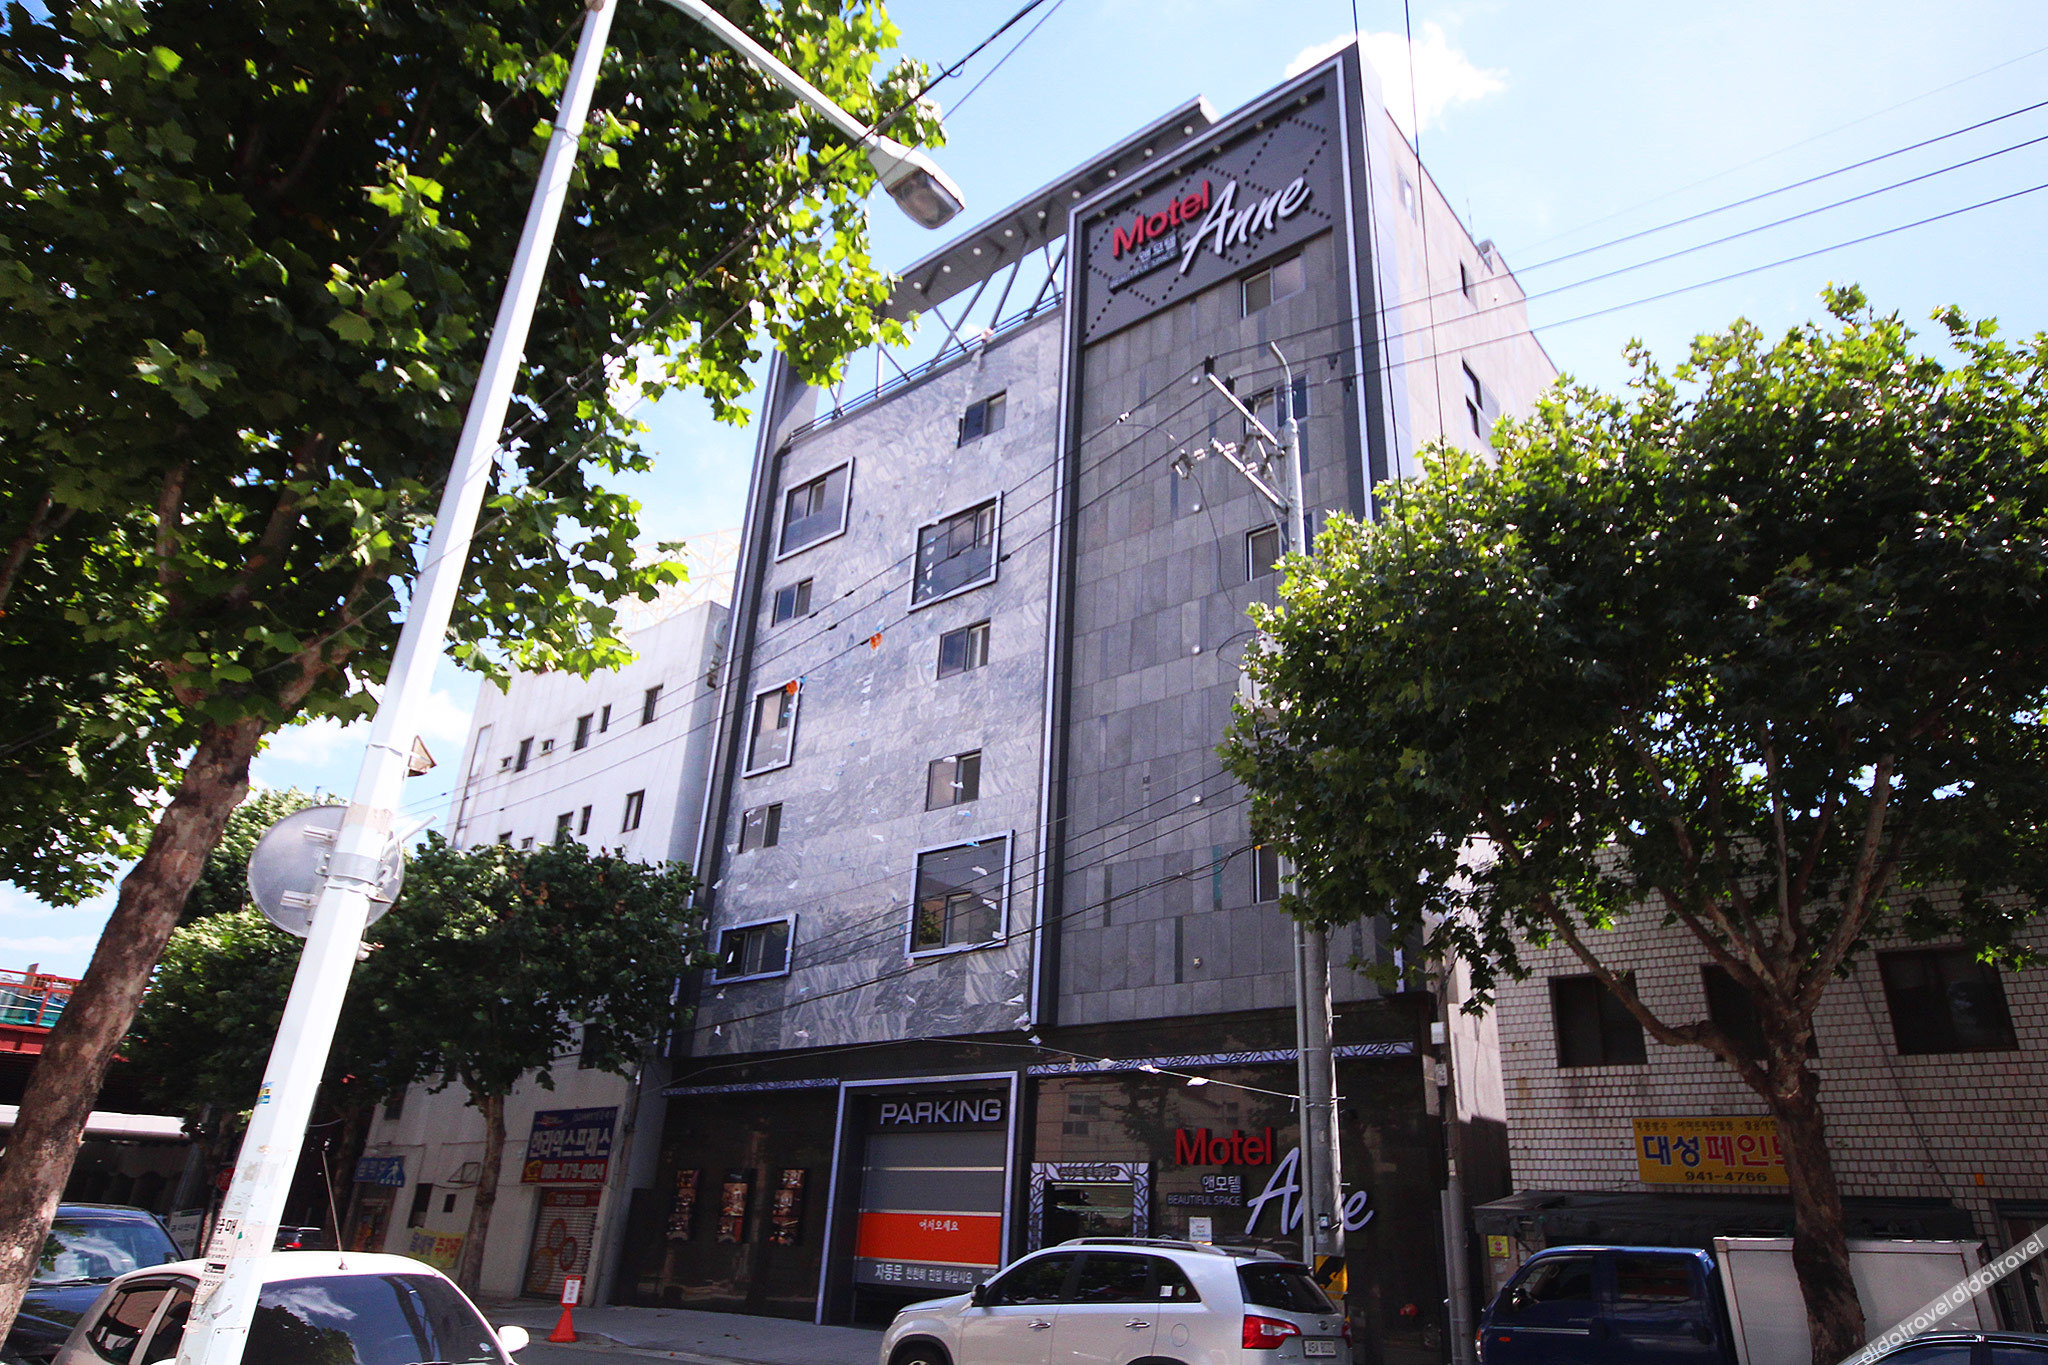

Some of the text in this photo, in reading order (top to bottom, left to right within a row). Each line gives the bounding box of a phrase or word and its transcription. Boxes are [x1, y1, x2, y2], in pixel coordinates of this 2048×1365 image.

[1112, 180, 1209, 257] Motel
[1179, 177, 1310, 274] Anne
[880, 1099, 1001, 1124] PARKING
[1175, 1127, 1272, 1165] Motel
[1643, 1135, 1700, 1167] 대성
[1202, 1175, 1241, 1194] 앤모텔
[1167, 1195, 1241, 1207] BEAUTIFUL SPACE
[919, 1219, 959, 1232] 어서오세요
[875, 1264, 903, 1281] 자동문
